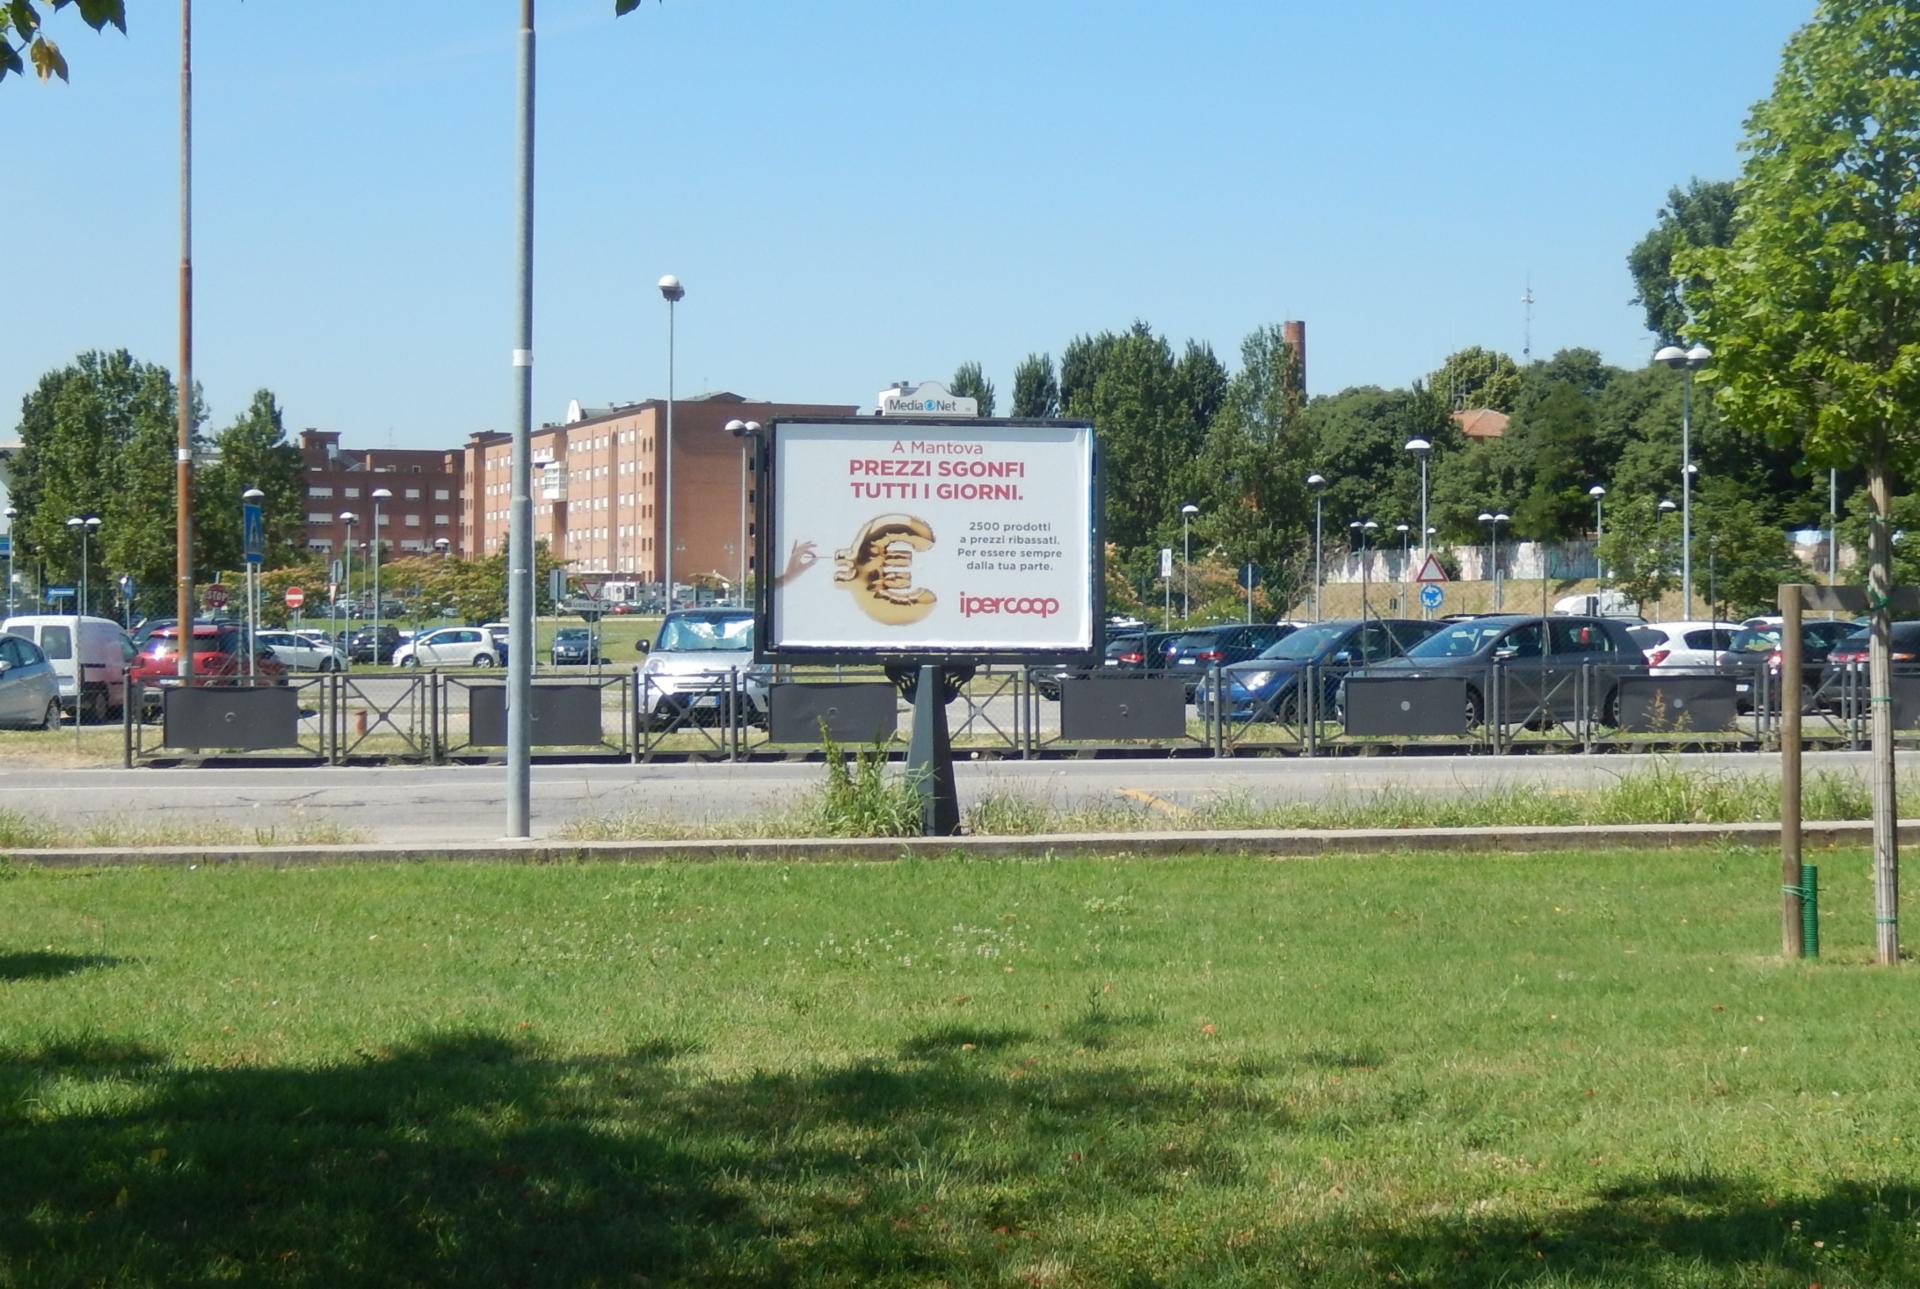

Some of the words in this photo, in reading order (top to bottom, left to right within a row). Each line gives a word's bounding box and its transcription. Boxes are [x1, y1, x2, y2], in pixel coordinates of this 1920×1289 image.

[889, 399, 923, 411] Media
[937, 399, 957, 411] Net
[892, 440, 905, 453] A
[911, 441, 983, 455] Mantova
[849, 459, 931, 476] PREZZI
[938, 461, 1024, 478] SGONFI
[850, 482, 917, 499] TUTTI
[924, 483, 930, 499] I
[936, 483, 1024, 500] GIORNI.
[969, 521, 1000, 531] 2500
[1003, 522, 1051, 532] prodotti
[960, 536, 967, 544] a
[970, 535, 1005, 545] prezzi
[1008, 535, 1060, 545] ribassati.
[957, 547, 976, 557] Per
[980, 549, 1016, 558] essere
[1020, 550, 1062, 559] sempre
[966, 561, 994, 570] dalla
[998, 562, 1016, 571] tua
[1020, 562, 1053, 572] parte.
[205, 590, 229, 600] STOP
[960, 591, 1060, 618] ipercoop
